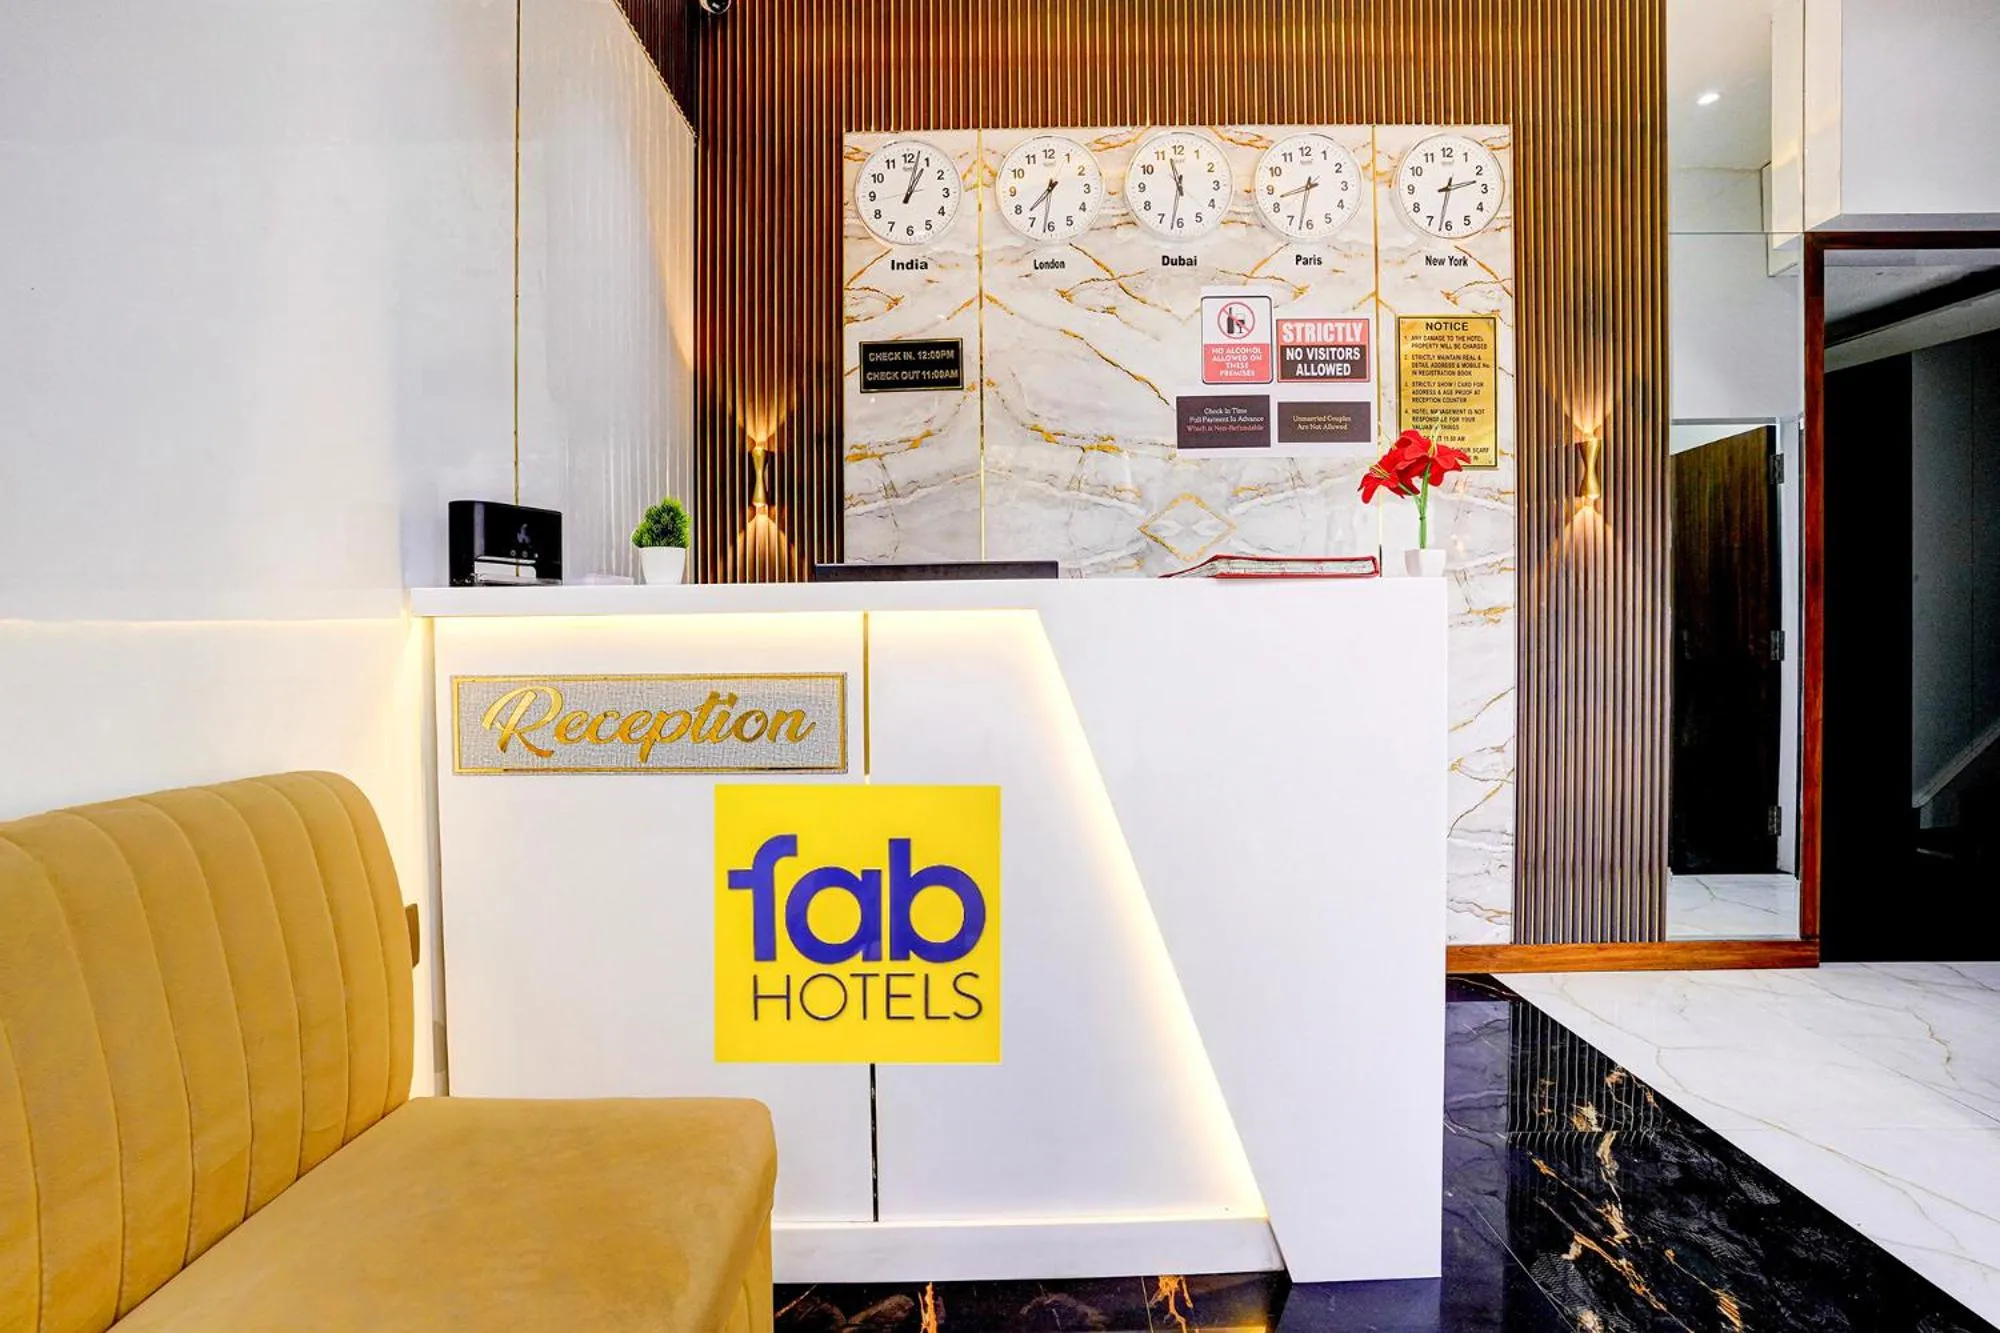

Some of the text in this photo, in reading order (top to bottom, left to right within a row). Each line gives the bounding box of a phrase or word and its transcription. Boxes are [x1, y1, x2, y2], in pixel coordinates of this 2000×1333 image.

[1043, 149, 1055, 159] 12
[1172, 145, 1184, 155] 12
[1195, 149, 1199, 159] 1
[1299, 146, 1311, 157] 12
[1322, 150, 1327, 160] 1
[1441, 148, 1453, 158] 12
[902, 153, 914, 163] 12
[1026, 154, 1036, 164] 11
[1065, 153, 1070, 163] 1
[1154, 151, 1165, 160] 11
[1282, 152, 1292, 162] 11
[1424, 153, 1434, 163] 11
[1464, 152, 1468, 162] 1
[886, 159, 895, 169] 11
[925, 157, 929, 167] 1
[1208, 162, 1214, 172] 2
[1078, 165, 1085, 176] 2
[1141, 164, 1154, 175] 10
[1269, 166, 1282, 177] 10
[1335, 163, 1342, 173] 2
[1410, 166, 1423, 176] 10
[1476, 165, 1483, 176] 2
[871, 173, 884, 183] 10
[937, 169, 944, 180] 2
[1011, 168, 1024, 179] 10
[1084, 183, 1091, 194] 3
[1138, 183, 1146, 192] 9
[1213, 180, 1220, 190] 3
[1266, 185, 1274, 195] 9
[1341, 181, 1348, 191] 3
[1408, 184, 1415, 195] 9
[1481, 184, 1488, 194] 3
[869, 191, 876, 201] 9
[942, 188, 950, 198] 3
[1009, 187, 1016, 197] 9
[1079, 202, 1086, 212] 4
[1144, 201, 1151, 211] 8
[1208, 199, 1215, 209] 4
[1273, 202, 1280, 213] 8
[1337, 200, 1344, 210] 4
[1413, 202, 1420, 213] 8
[1476, 202, 1484, 212] 4
[874, 209, 882, 219] 8
[938, 206, 945, 216] 4
[1015, 204, 1022, 215] 8
[1029, 217, 1036, 227] 7
[1066, 216, 1073, 226] 5
[1158, 213, 1165, 224] 7
[1195, 212, 1203, 223] 5
[1287, 215, 1294, 226] 7
[1325, 213, 1332, 224] 5
[1426, 216, 1434, 226] 7
[1464, 216, 1471, 226] 5
[888, 221, 895, 232] 7
[925, 220, 932, 230] 5
[1047, 221, 1055, 232] 6
[1177, 218, 1184, 228] 6
[1306, 220, 1313, 230] 6
[1445, 221, 1452, 231] 6
[906, 226, 913, 236] 6
[891, 259, 928, 270] India
[1034, 259, 1065, 269] London
[1162, 256, 1197, 266] Dubai
[1296, 254, 1322, 265] Paris
[1426, 256, 1468, 266] New York
[1426, 322, 1468, 331] NOTICE
[1282, 322, 1363, 343] STRICTLY
[869, 352, 901, 361] CHECK
[917, 350, 954, 360] 12:00PM
[1286, 348, 1360, 360] NO VISITORS
[1296, 363, 1351, 376] ALLOWED
[866, 369, 958, 381] CHECK OUT 11:00AM
[482, 686, 816, 763] Reception
[727, 834, 986, 964] fab
[753, 972, 983, 1021] HOTELS
